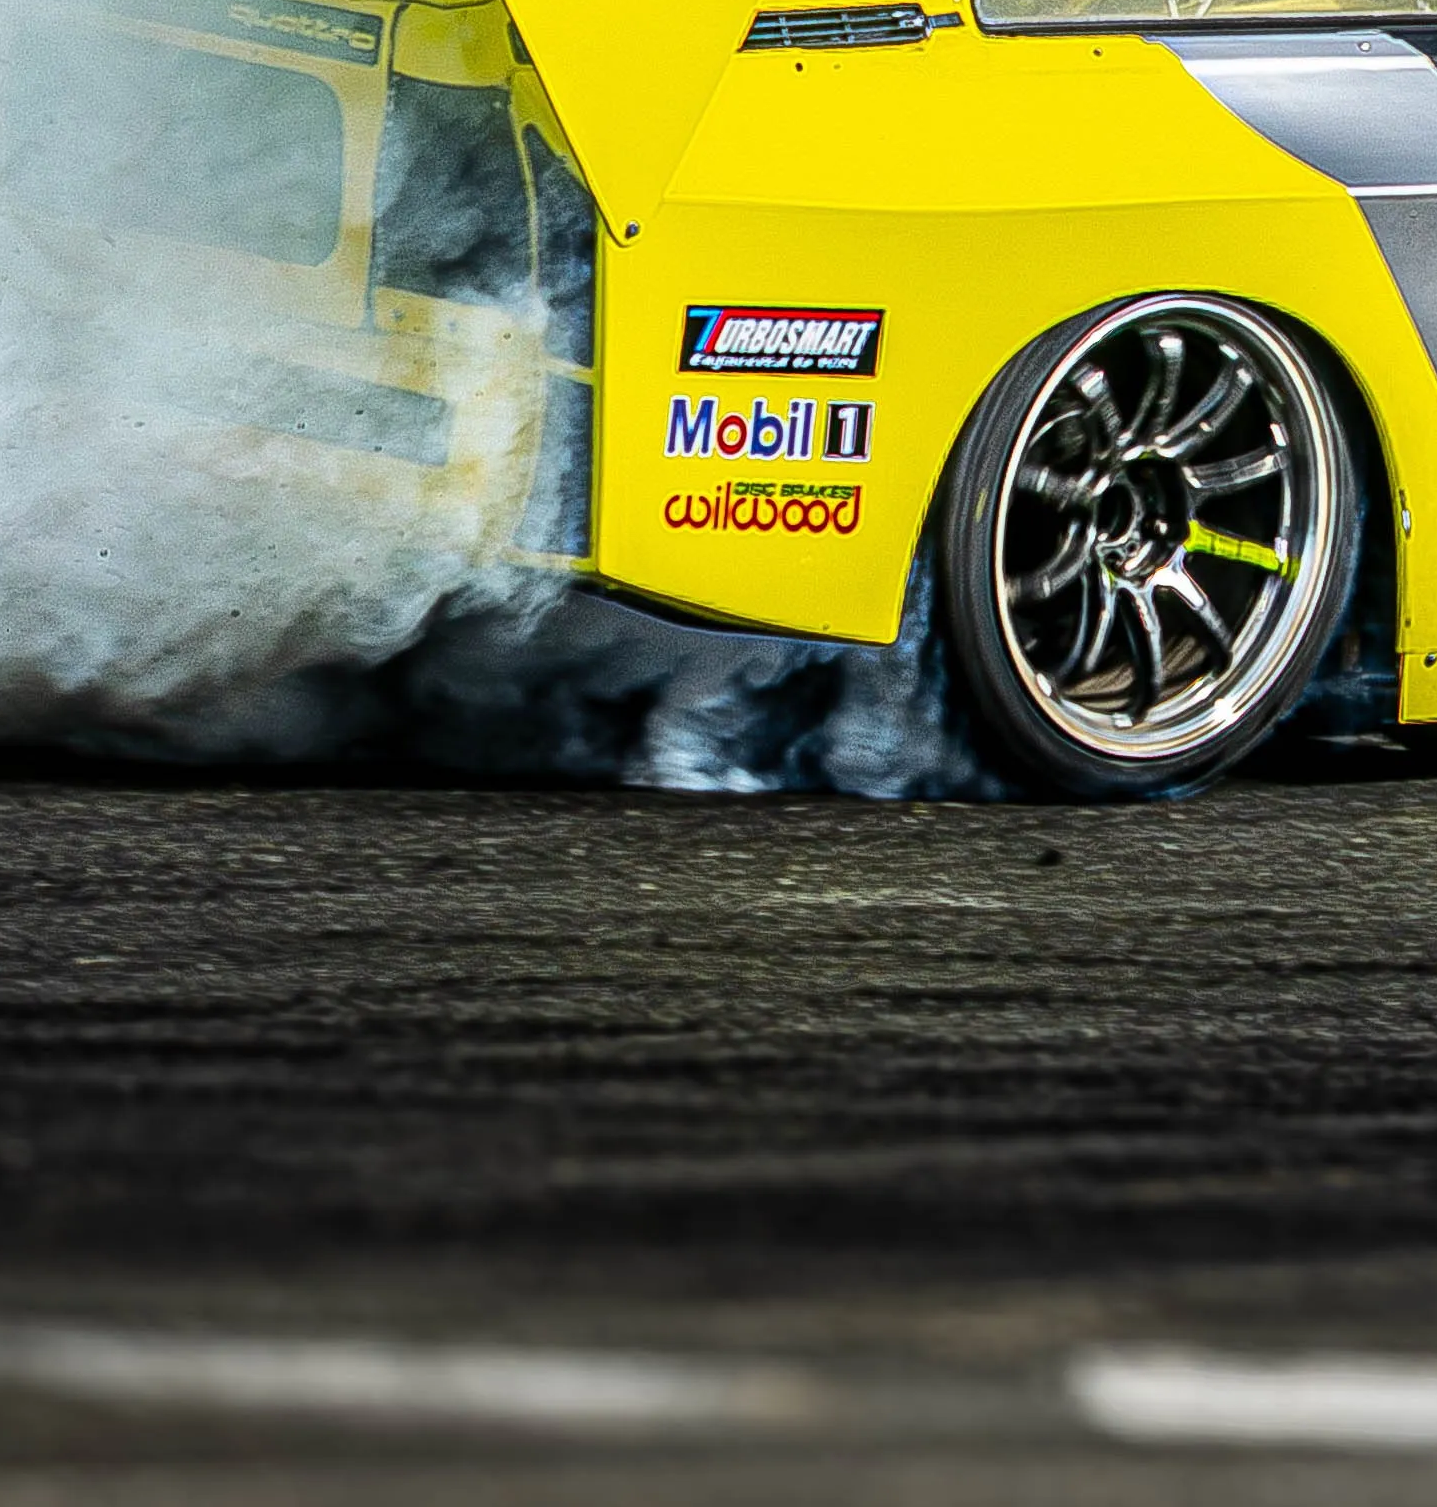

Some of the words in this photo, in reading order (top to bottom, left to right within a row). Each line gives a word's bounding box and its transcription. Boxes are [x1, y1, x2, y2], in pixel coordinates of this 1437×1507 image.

[688, 308, 879, 356] TURBOSMART
[666, 397, 815, 458] Mobil
[835, 405, 862, 456] 1
[664, 481, 862, 534] wilwood
